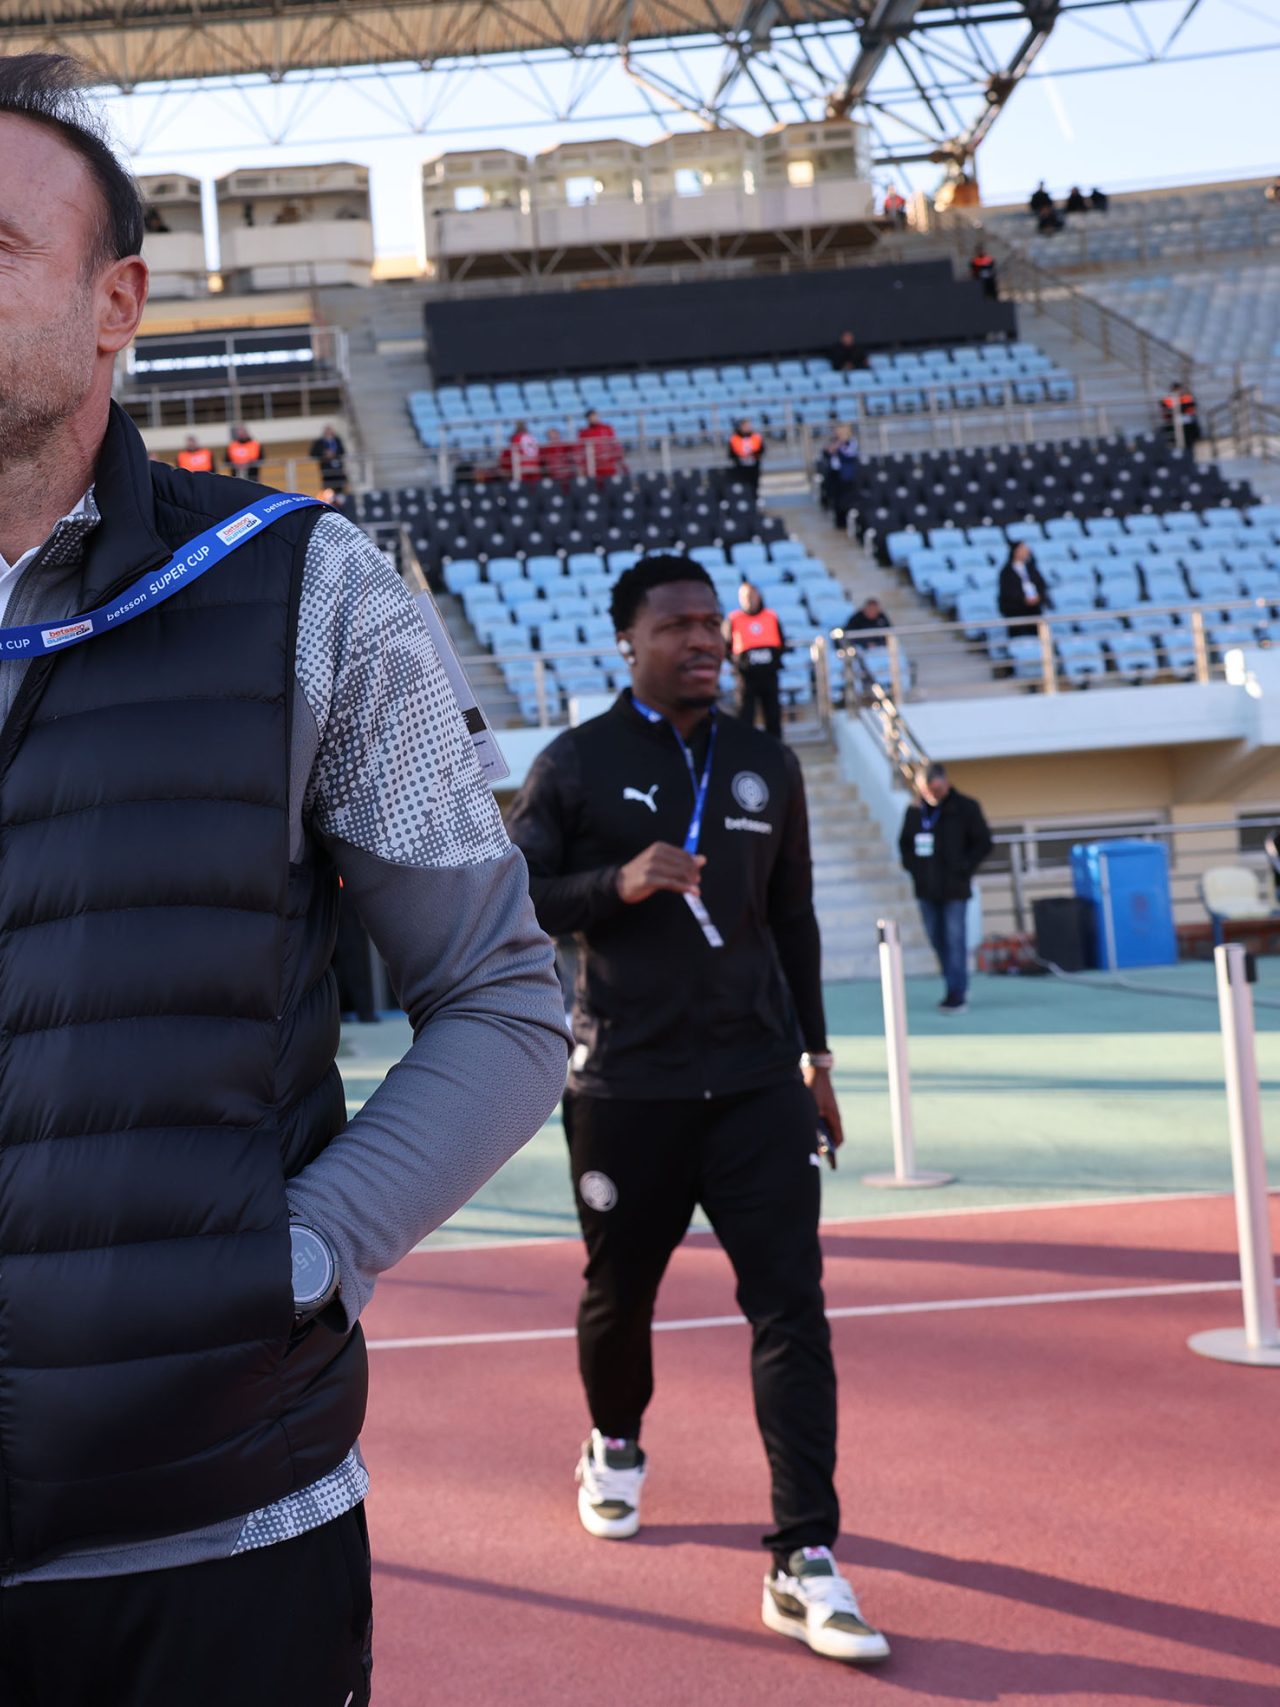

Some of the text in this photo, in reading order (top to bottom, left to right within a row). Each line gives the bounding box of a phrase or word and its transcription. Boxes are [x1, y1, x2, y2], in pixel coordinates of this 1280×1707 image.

[263, 498, 294, 514] betsson
[222, 517, 250, 536] betsson
[106, 545, 210, 621] betsson SUPER CUP
[48, 623, 85, 638] betsson
[6, 638, 31, 650] CUP
[724, 816, 773, 835] betsson
